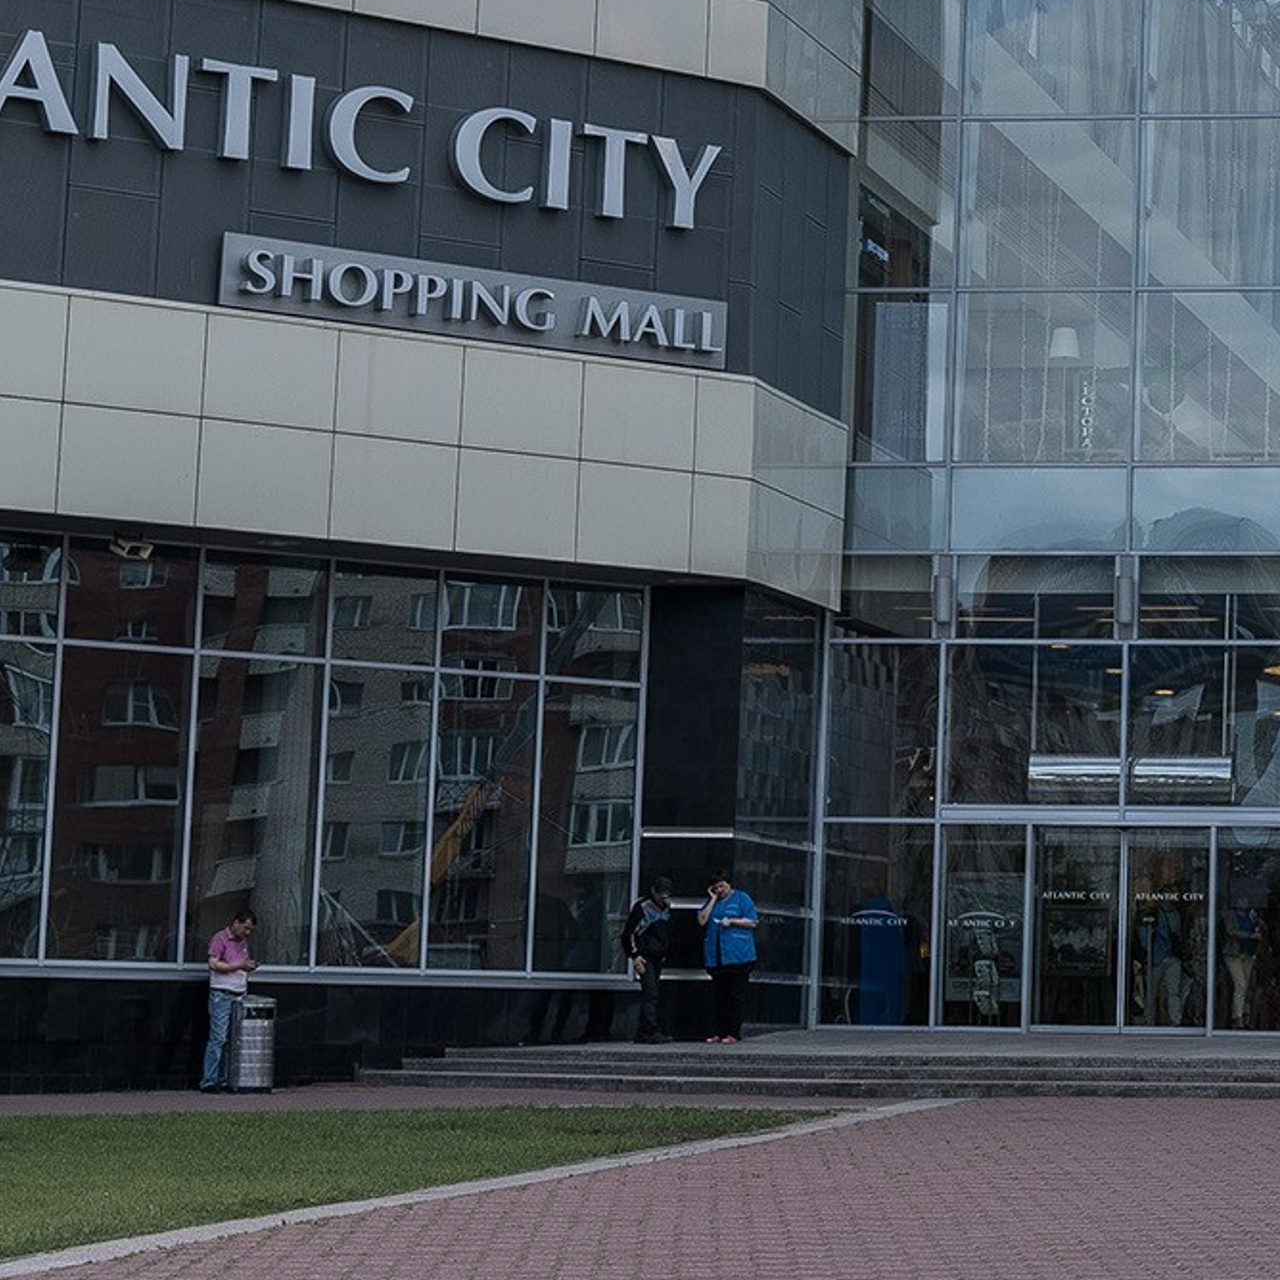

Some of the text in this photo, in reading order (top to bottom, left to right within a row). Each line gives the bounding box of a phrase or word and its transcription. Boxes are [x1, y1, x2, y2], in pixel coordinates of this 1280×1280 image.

[448, 107, 723, 230] CITY
[240, 248, 724, 353] SHOPPING MALL
[1042, 891, 1111, 900] ATLANTIC CITY
[1134, 892, 1205, 902] ATLANTIC CITY
[886, 917, 909, 926] CITY
[993, 919, 1016, 928] CIY
